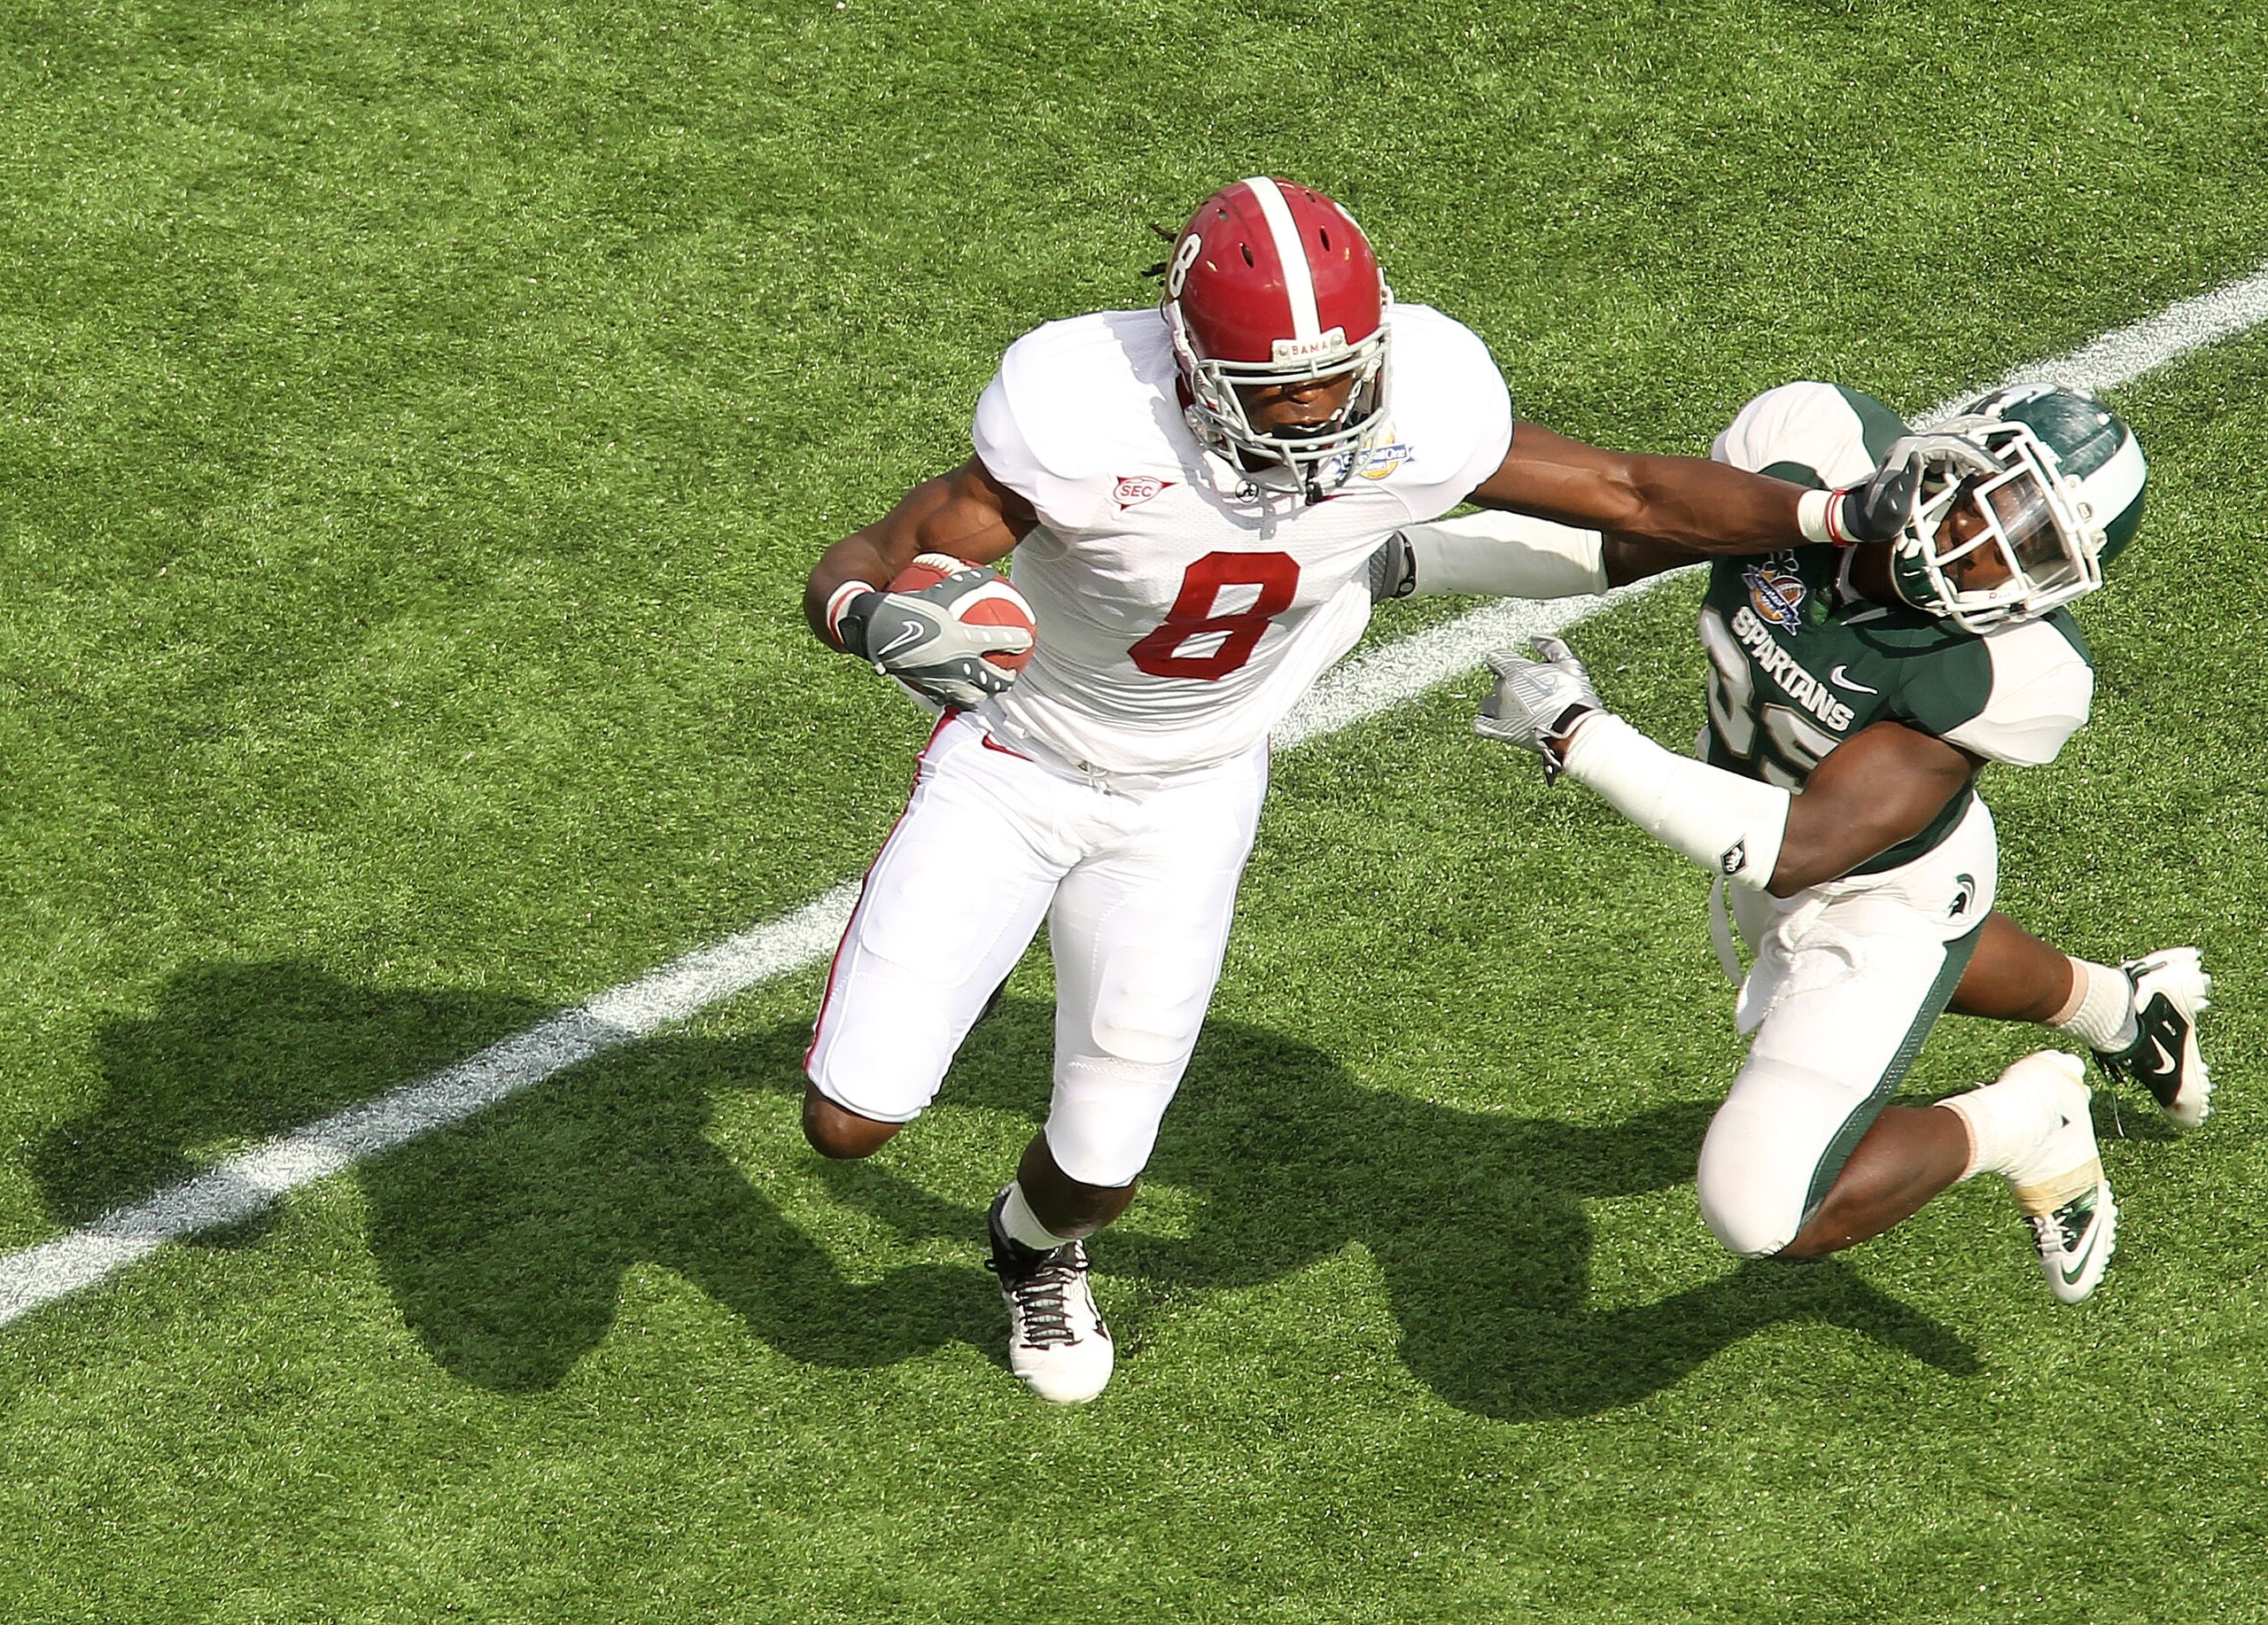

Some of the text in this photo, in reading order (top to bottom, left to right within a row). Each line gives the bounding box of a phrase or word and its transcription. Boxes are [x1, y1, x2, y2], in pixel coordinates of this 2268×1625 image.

[1169, 233, 1202, 299] 8
[1292, 340, 1329, 355] BAMA
[1120, 485, 1153, 498] SEC
[1127, 550, 1301, 681] 8
[1730, 605, 1856, 732] SPARTANS
